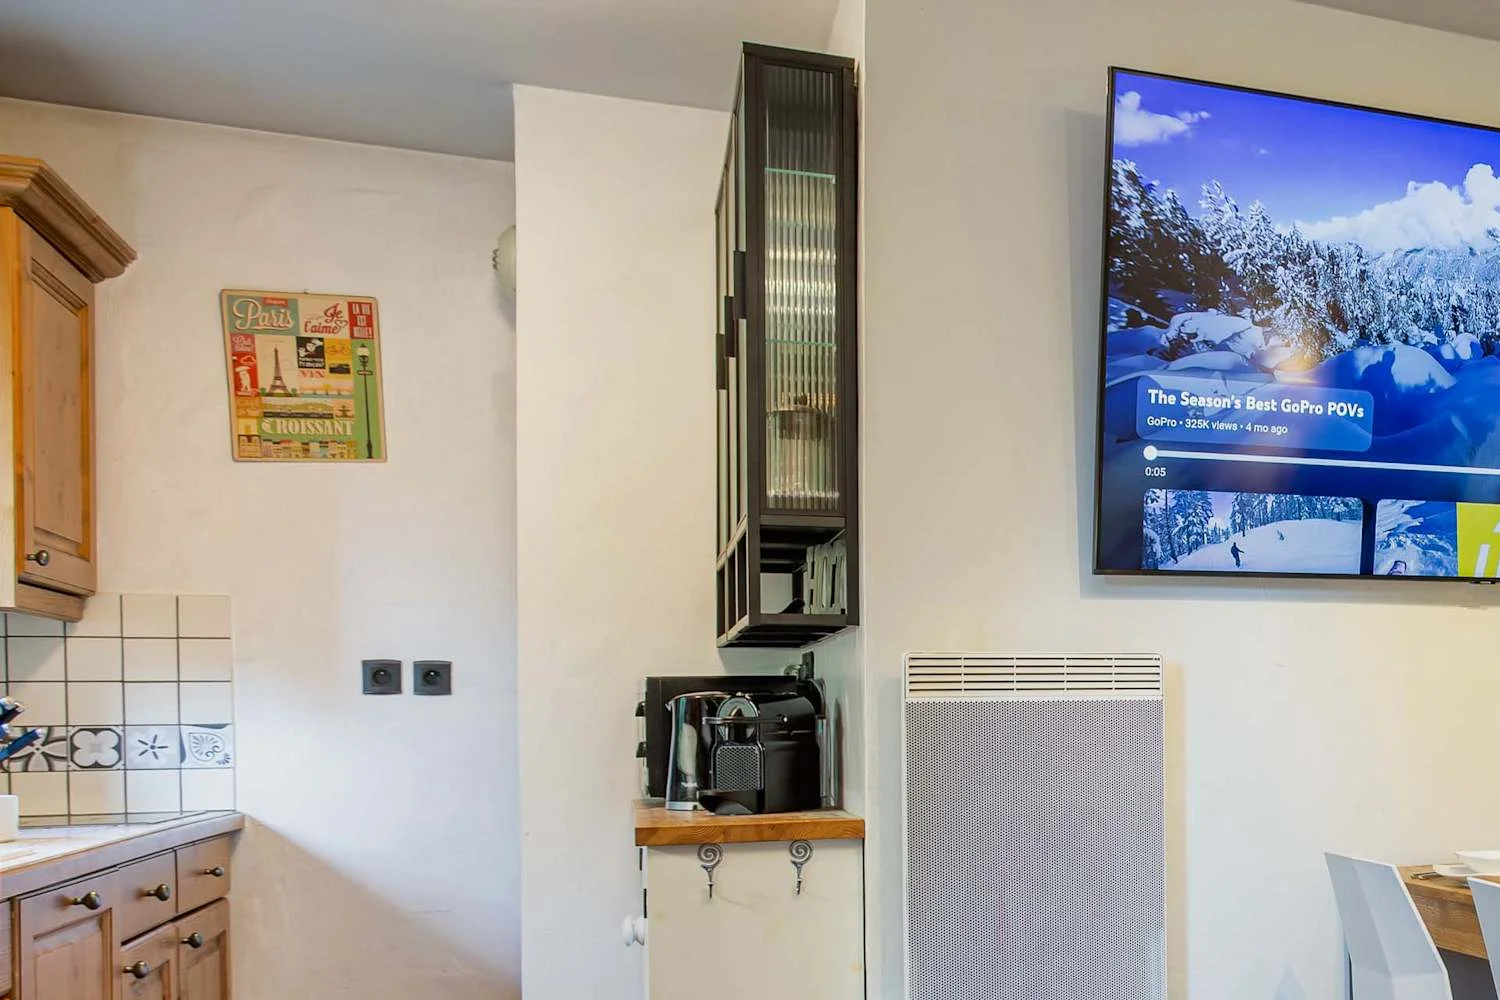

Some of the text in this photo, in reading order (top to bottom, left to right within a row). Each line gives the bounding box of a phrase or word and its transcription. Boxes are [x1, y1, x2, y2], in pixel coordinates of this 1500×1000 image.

[233, 298, 295, 330] Paris
[324, 303, 343, 323] Je
[1147, 389, 1365, 418] The Season's Best GoPro POVs
[261, 418, 354, 436] CROISSANT
[1147, 416, 1288, 436] GoPro 325K views 4 mo ago
[1144, 466, 1167, 477] 0:05
